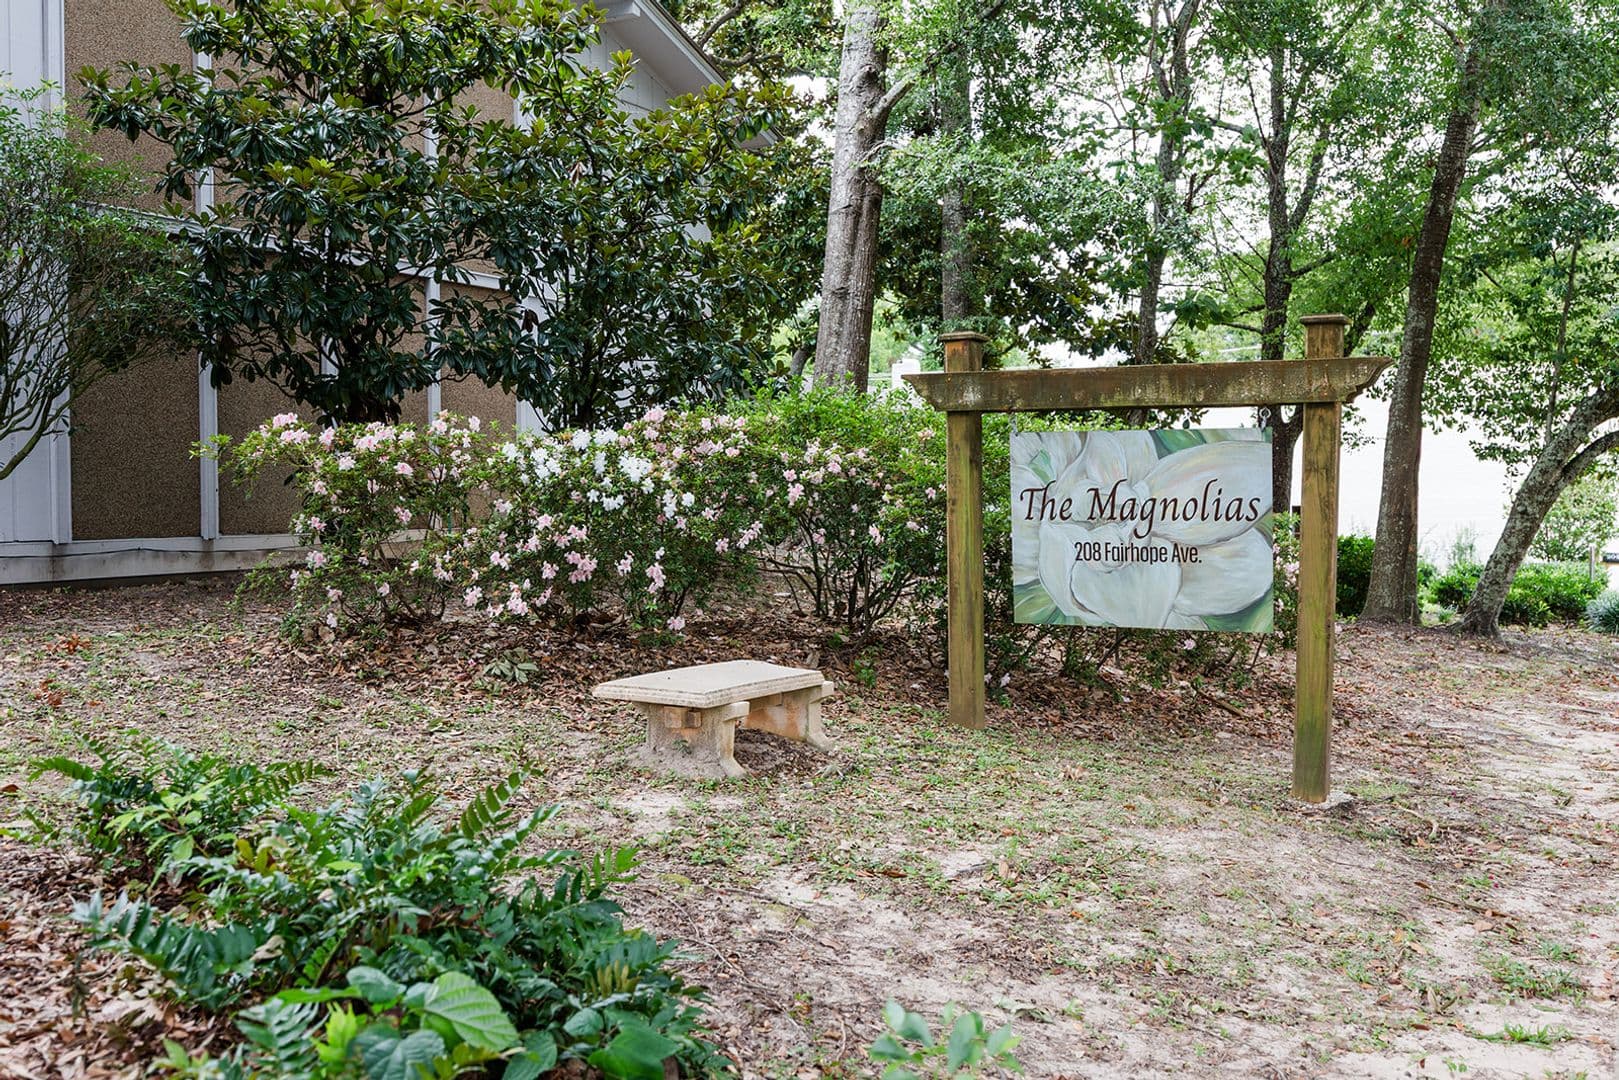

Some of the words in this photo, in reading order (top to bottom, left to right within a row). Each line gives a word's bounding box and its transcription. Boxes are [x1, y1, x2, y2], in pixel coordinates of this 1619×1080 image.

[1020, 479, 1073, 521] The
[1086, 478, 1261, 539] Magnolias
[1074, 542, 1101, 562] 208
[1105, 542, 1168, 565] Fairhope
[1171, 543, 1202, 564] Ave.
